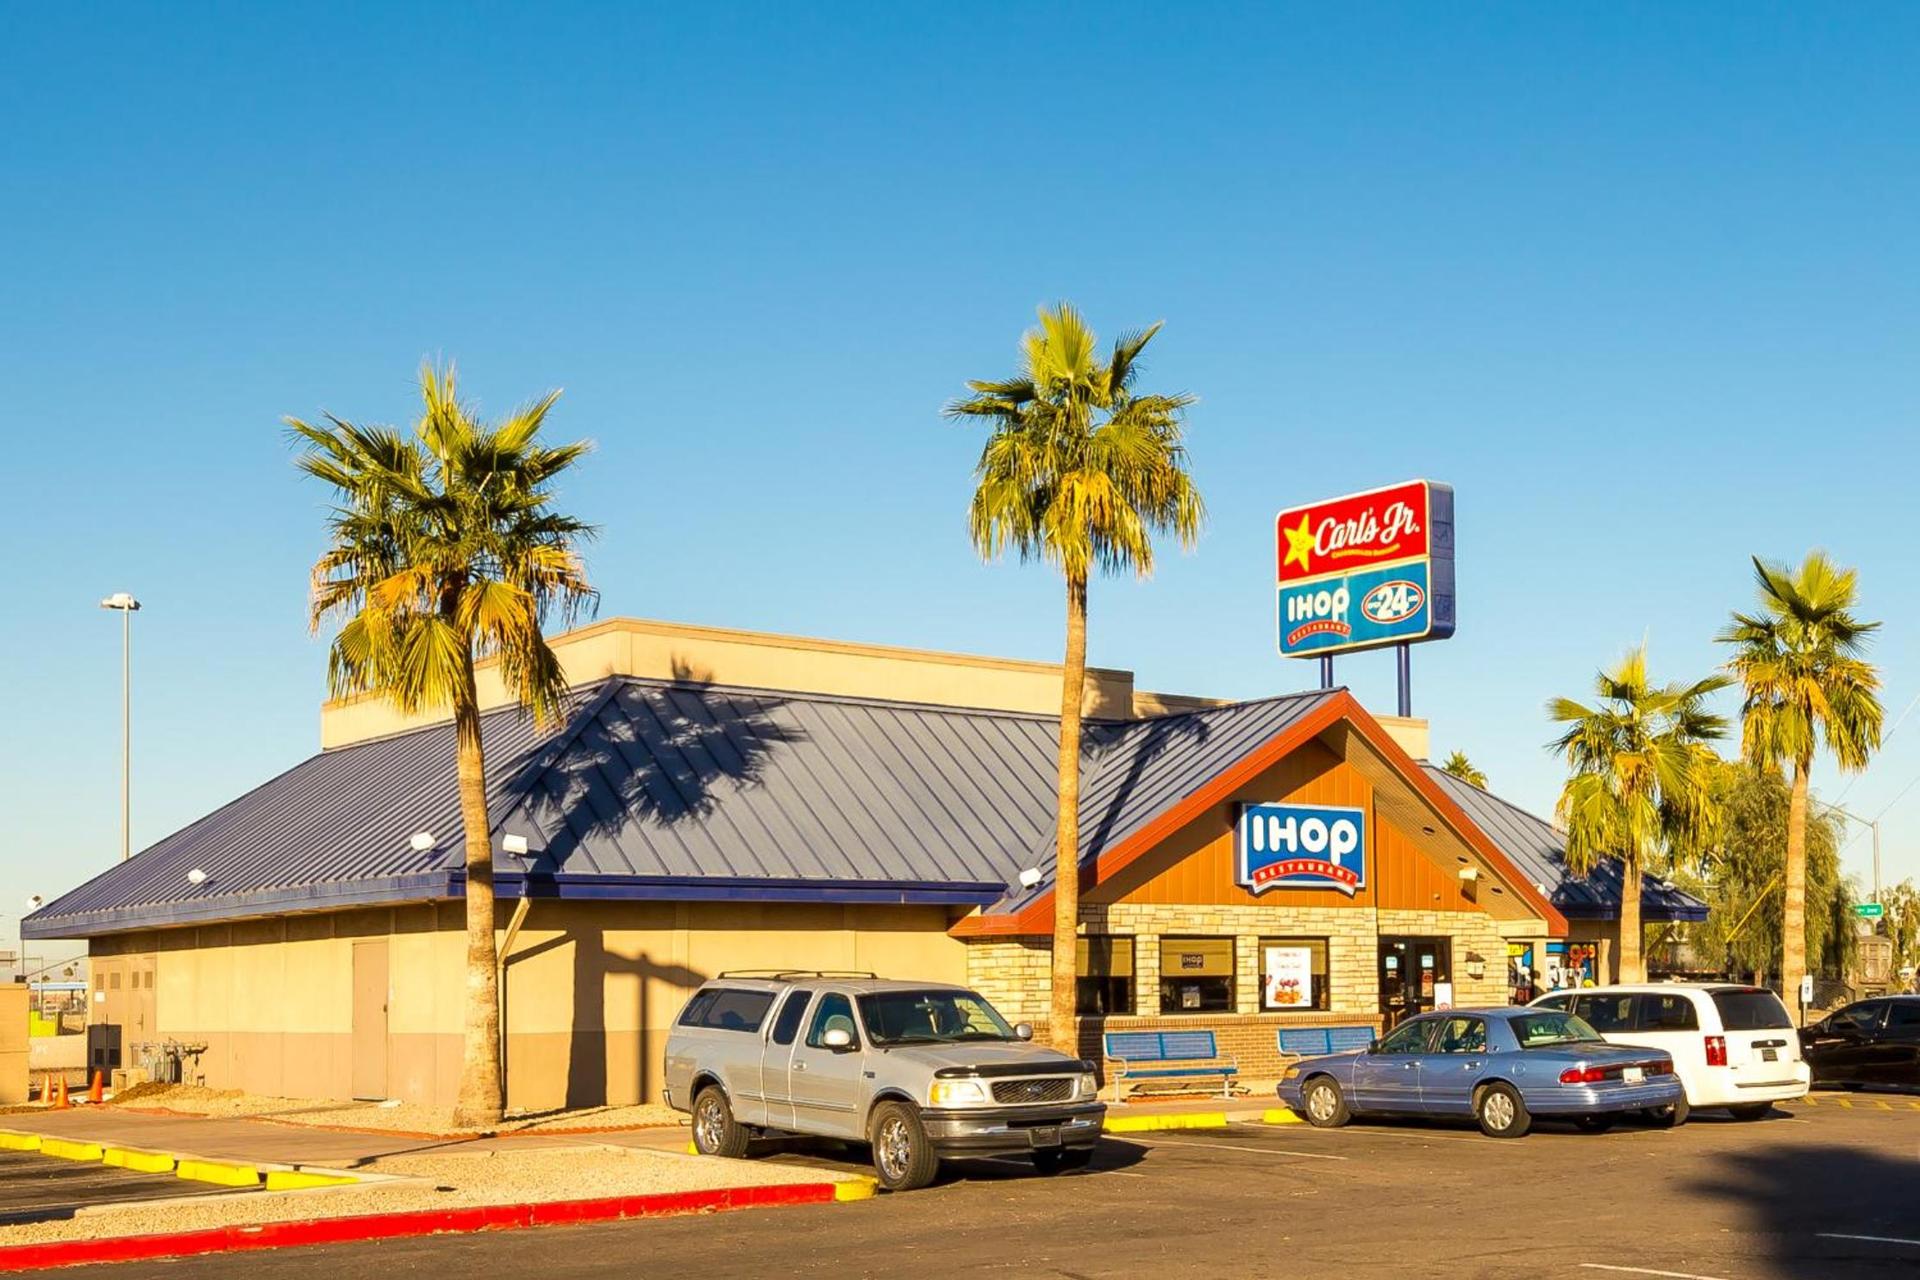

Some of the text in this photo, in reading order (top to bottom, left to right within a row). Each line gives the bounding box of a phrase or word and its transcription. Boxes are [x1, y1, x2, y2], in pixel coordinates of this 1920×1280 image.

[1314, 501, 1420, 556] Carl's Jr.
[1288, 587, 1350, 623] IHOP
[1253, 815, 1358, 866] IHOP
[1259, 862, 1353, 882] RESTAURANT
